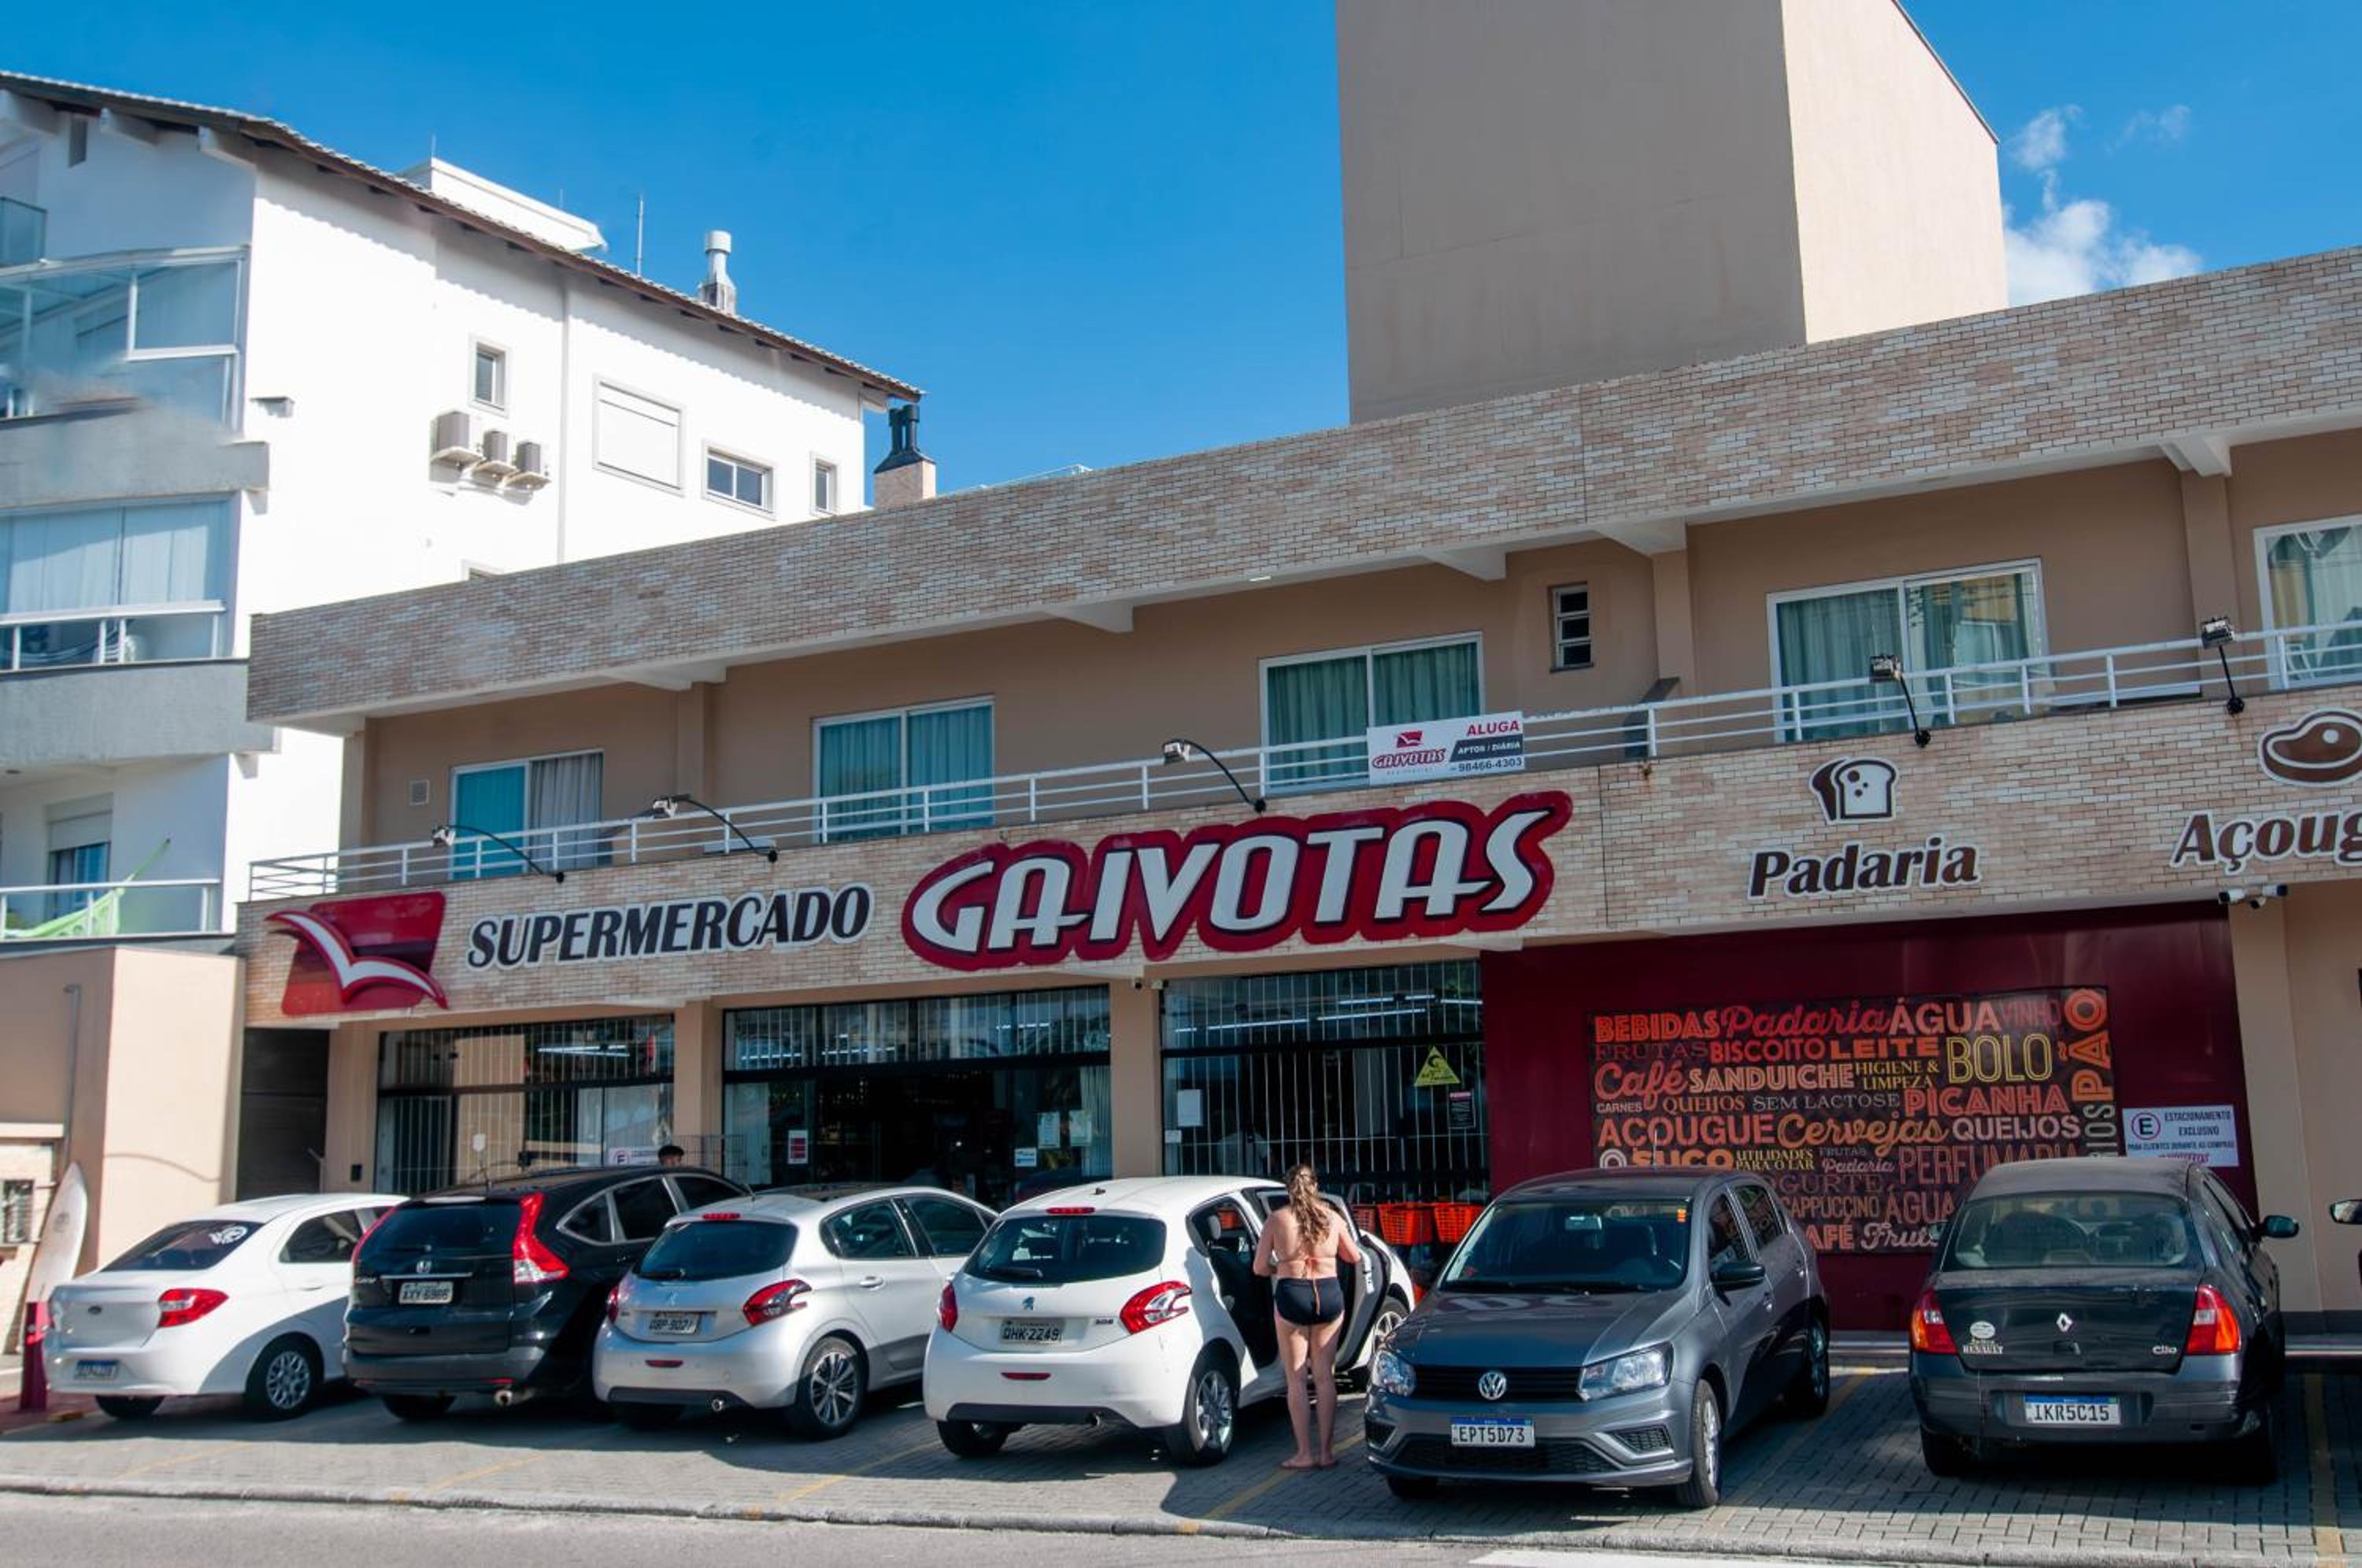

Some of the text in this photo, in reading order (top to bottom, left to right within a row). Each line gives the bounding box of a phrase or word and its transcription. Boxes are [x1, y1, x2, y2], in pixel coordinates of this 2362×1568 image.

[1467, 720, 1520, 737] ALUGA
[1372, 749, 1446, 769] GAIVOTAS
[1749, 835, 1980, 899] Padaria
[911, 810, 1551, 953] GAIVOTAS
[468, 883, 872, 970] SUPERMERCADO
[1595, 1010, 1720, 1043] BEBIDAS
[1720, 1000, 1890, 1037] Padaria
[1890, 997, 2002, 1034] ÁGUA
[2057, 988, 2115, 1102] PÃO
[1595, 1033, 2053, 1084] FRUTAS BISCOITO LEITE BOLO
[1594, 1059, 1940, 1111] Café SANDUICHE HIGIENE &
[1863, 1074, 1934, 1090] LIMPEZA
[1597, 1085, 2071, 1117] CARNES QUEIJOS SEM LACTOSE PICANHA
[2138, 1117, 2154, 1136] E
[2164, 1111, 2231, 1122] ESTACIONAMENTO
[1776, 1111, 1950, 1158] Cervejas
[1952, 1115, 2081, 1141] QUEIJOS
[2179, 1126, 2220, 1137] EXCLUSIVO
[1735, 1148, 1814, 1161] UTILIDADES
[1735, 1159, 1770, 1171] PARA
[1773, 1159, 1785, 1170] O
[1787, 1158, 1815, 1170] LAR
[1821, 1157, 1895, 1173] Padaria
[1805, 1218, 1855, 1250] AFÉ
[2034, 1404, 2110, 1422] IKR5C15
[1458, 1426, 1526, 1444] EPT5D73
